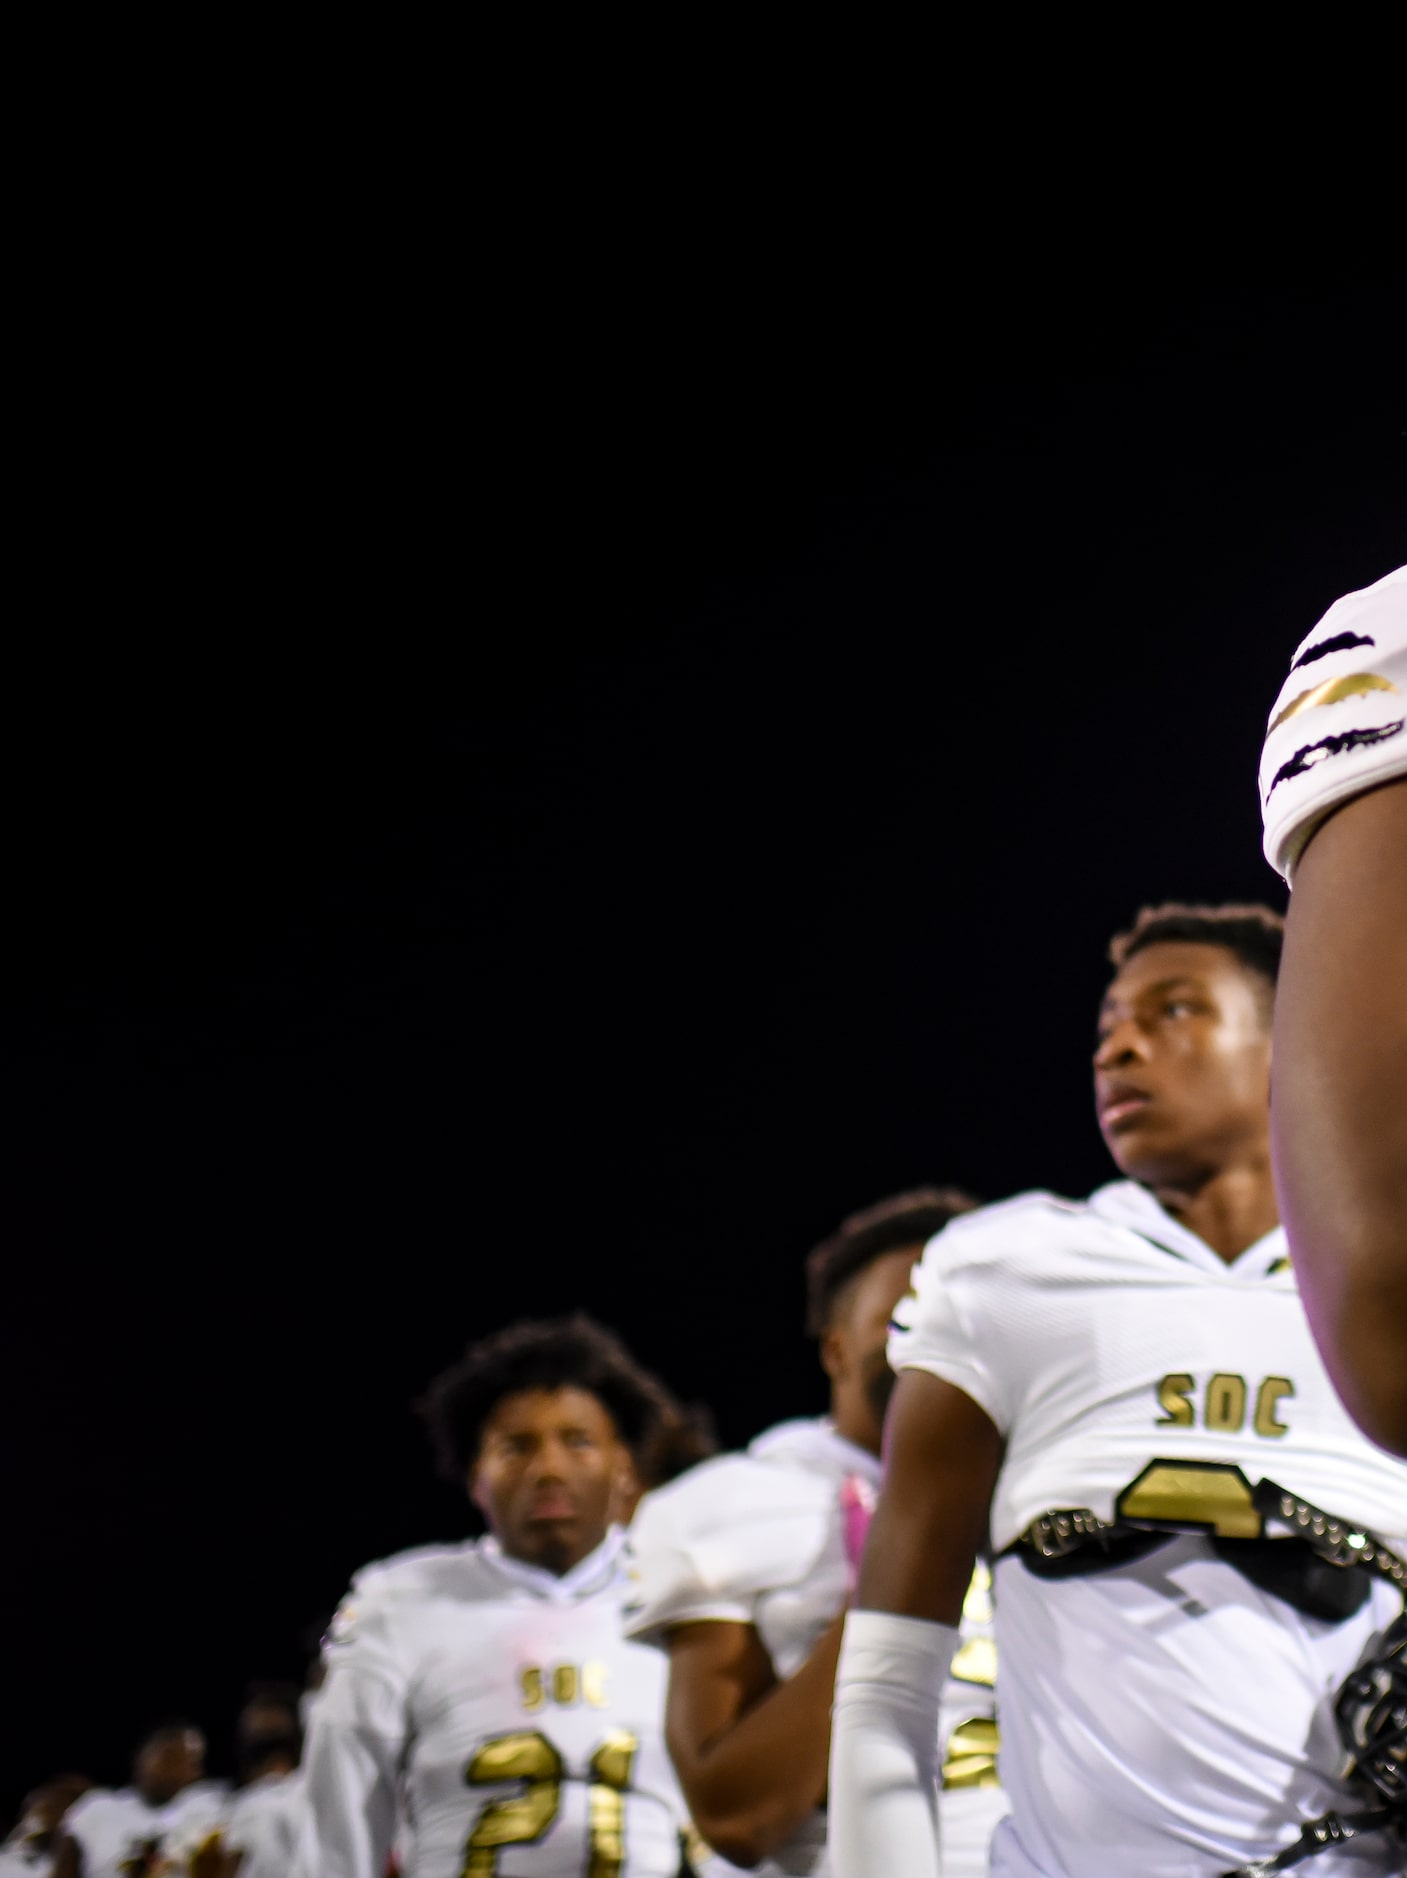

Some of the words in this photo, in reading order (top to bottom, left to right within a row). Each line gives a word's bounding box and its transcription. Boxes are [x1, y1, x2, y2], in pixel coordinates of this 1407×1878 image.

[1156, 1373, 1295, 1437] SOC
[519, 1662, 610, 1711] SOC
[464, 1727, 641, 1878] 21
